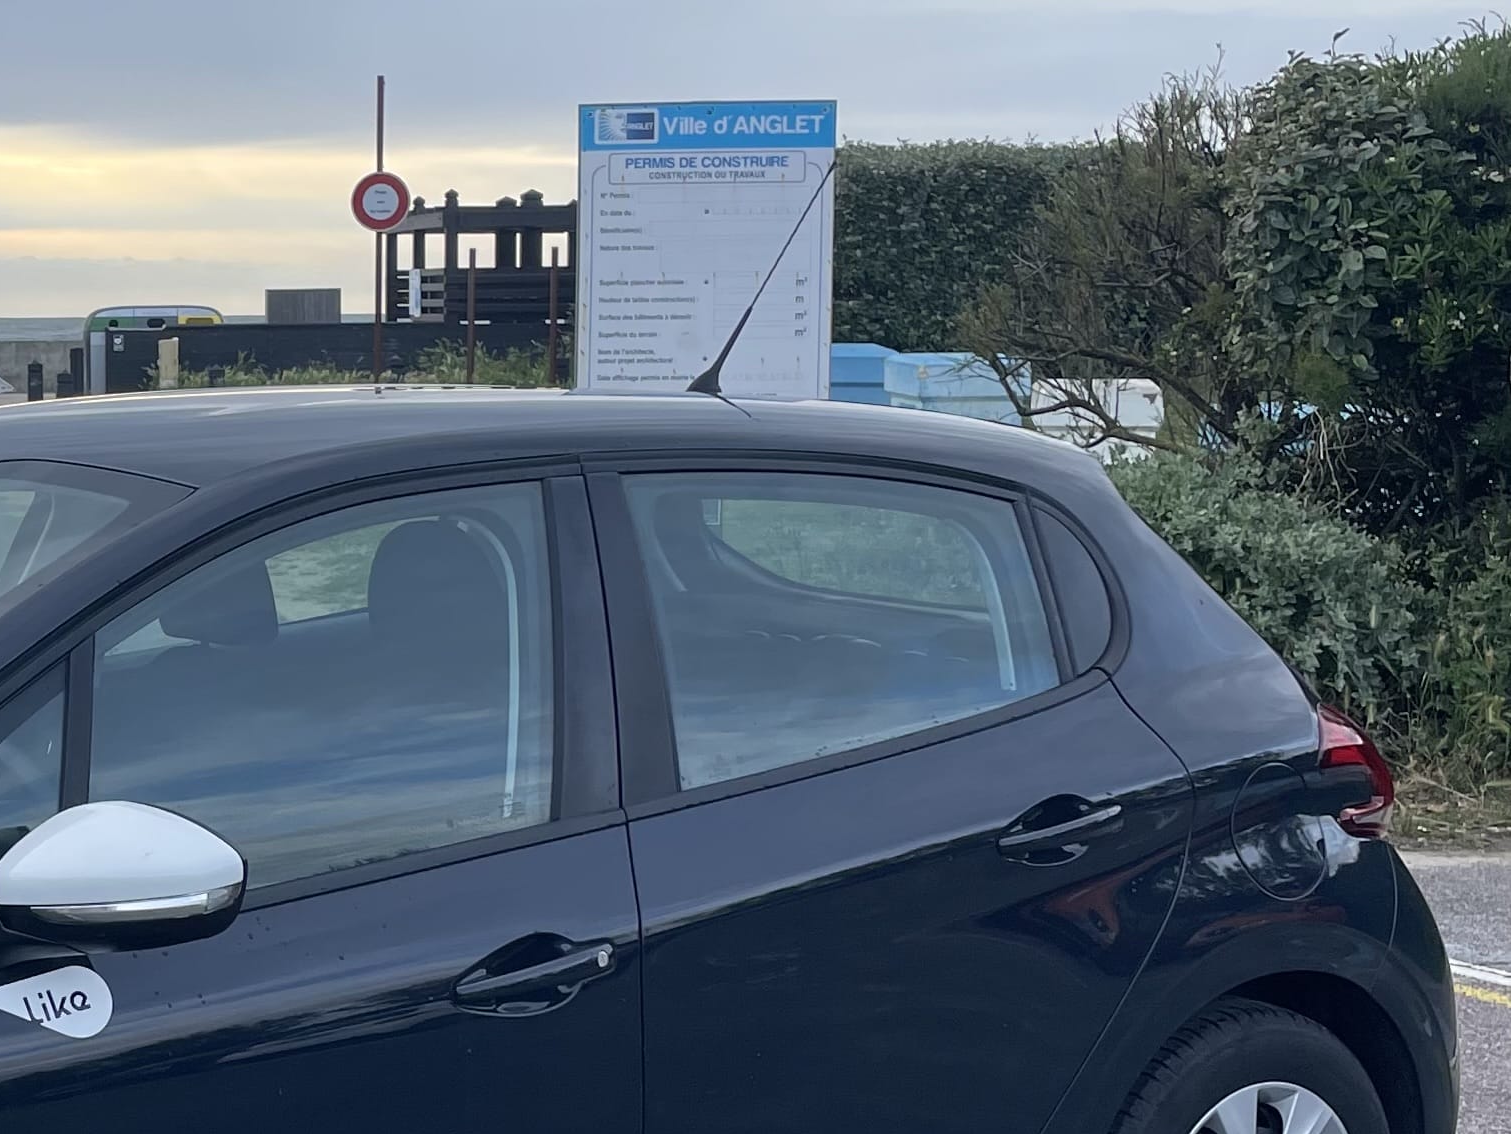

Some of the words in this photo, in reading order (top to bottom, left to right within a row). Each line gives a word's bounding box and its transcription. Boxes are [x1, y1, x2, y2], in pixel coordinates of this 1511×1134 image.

[662, 116, 707, 135] Ville
[625, 157, 675, 169] PERMIS
[679, 157, 698, 169] DE
[701, 155, 789, 168] CONSTRUIRE
[648, 170, 712, 180] CONSTRUCTION
[714, 171, 726, 179] OU
[728, 170, 766, 179] TRAVAUX
